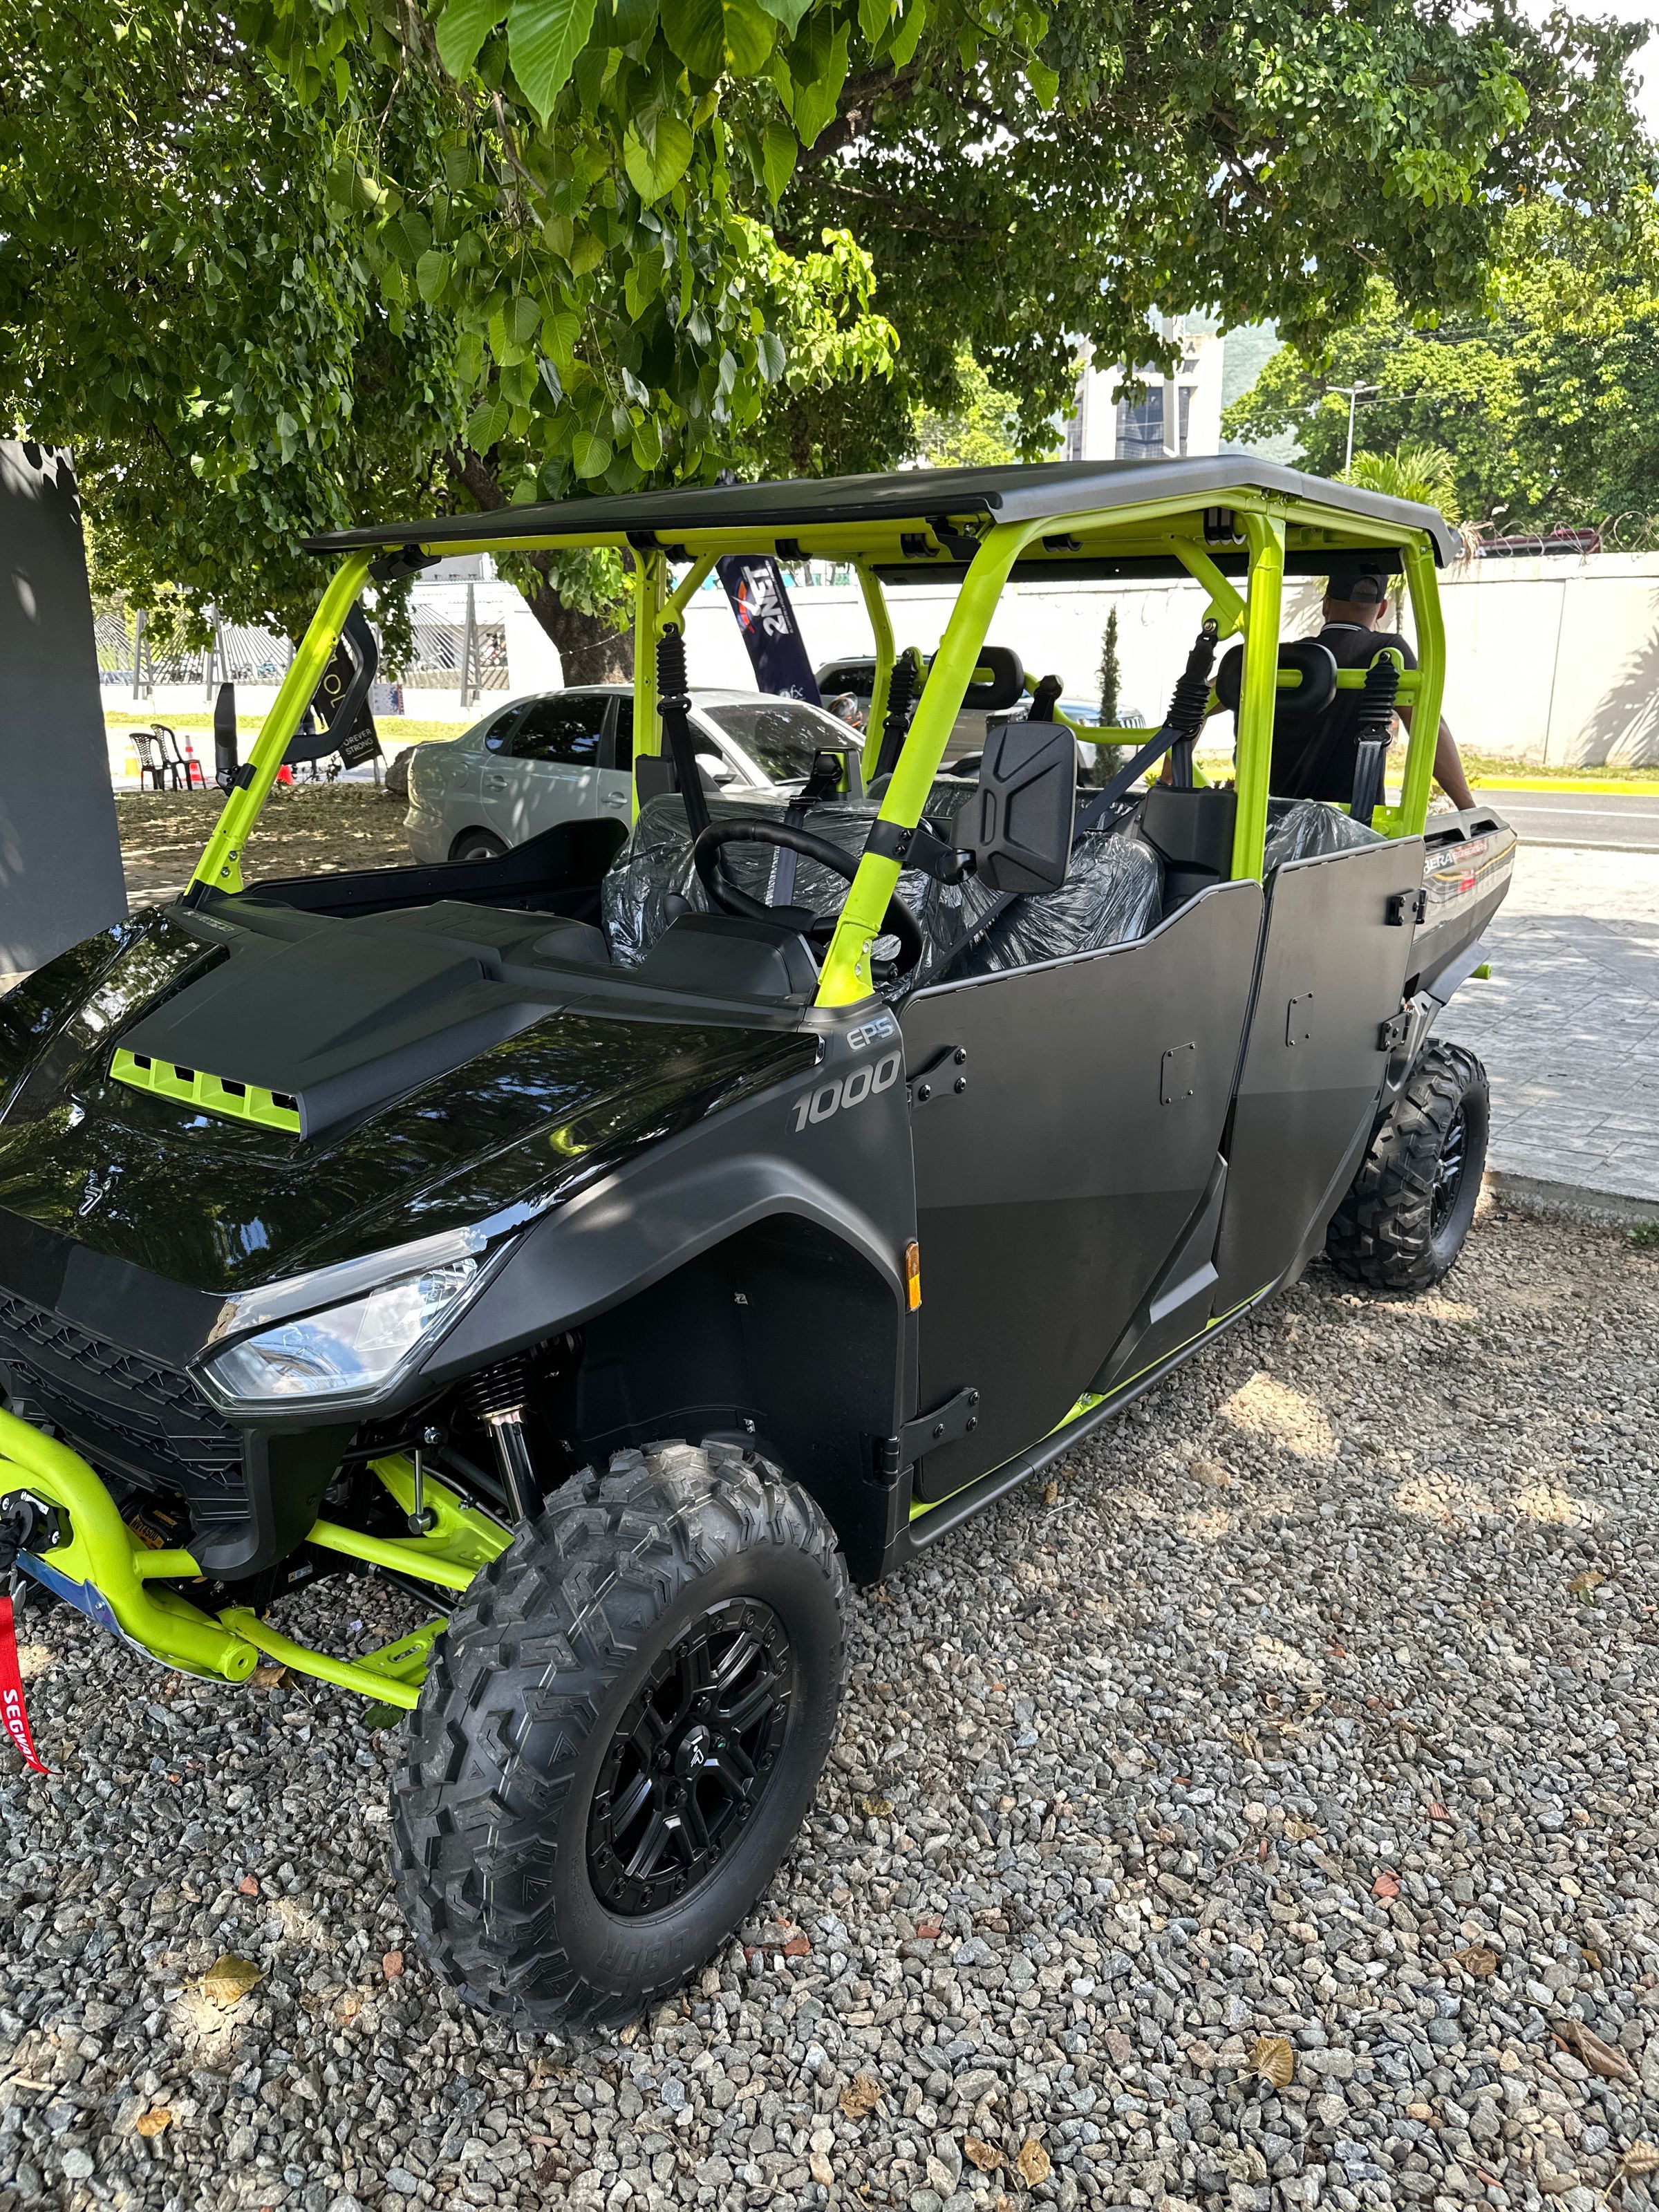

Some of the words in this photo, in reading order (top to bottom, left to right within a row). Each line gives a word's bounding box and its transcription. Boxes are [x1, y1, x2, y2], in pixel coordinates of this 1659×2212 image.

[743, 565, 789, 637] 2NET
[342, 729, 372, 746] OREVER
[346, 738, 373, 755] STRONG
[846, 1015, 894, 1050] EPS
[791, 1050, 901, 1132] 1000
[3, 1689, 38, 1765] SEGWAY
